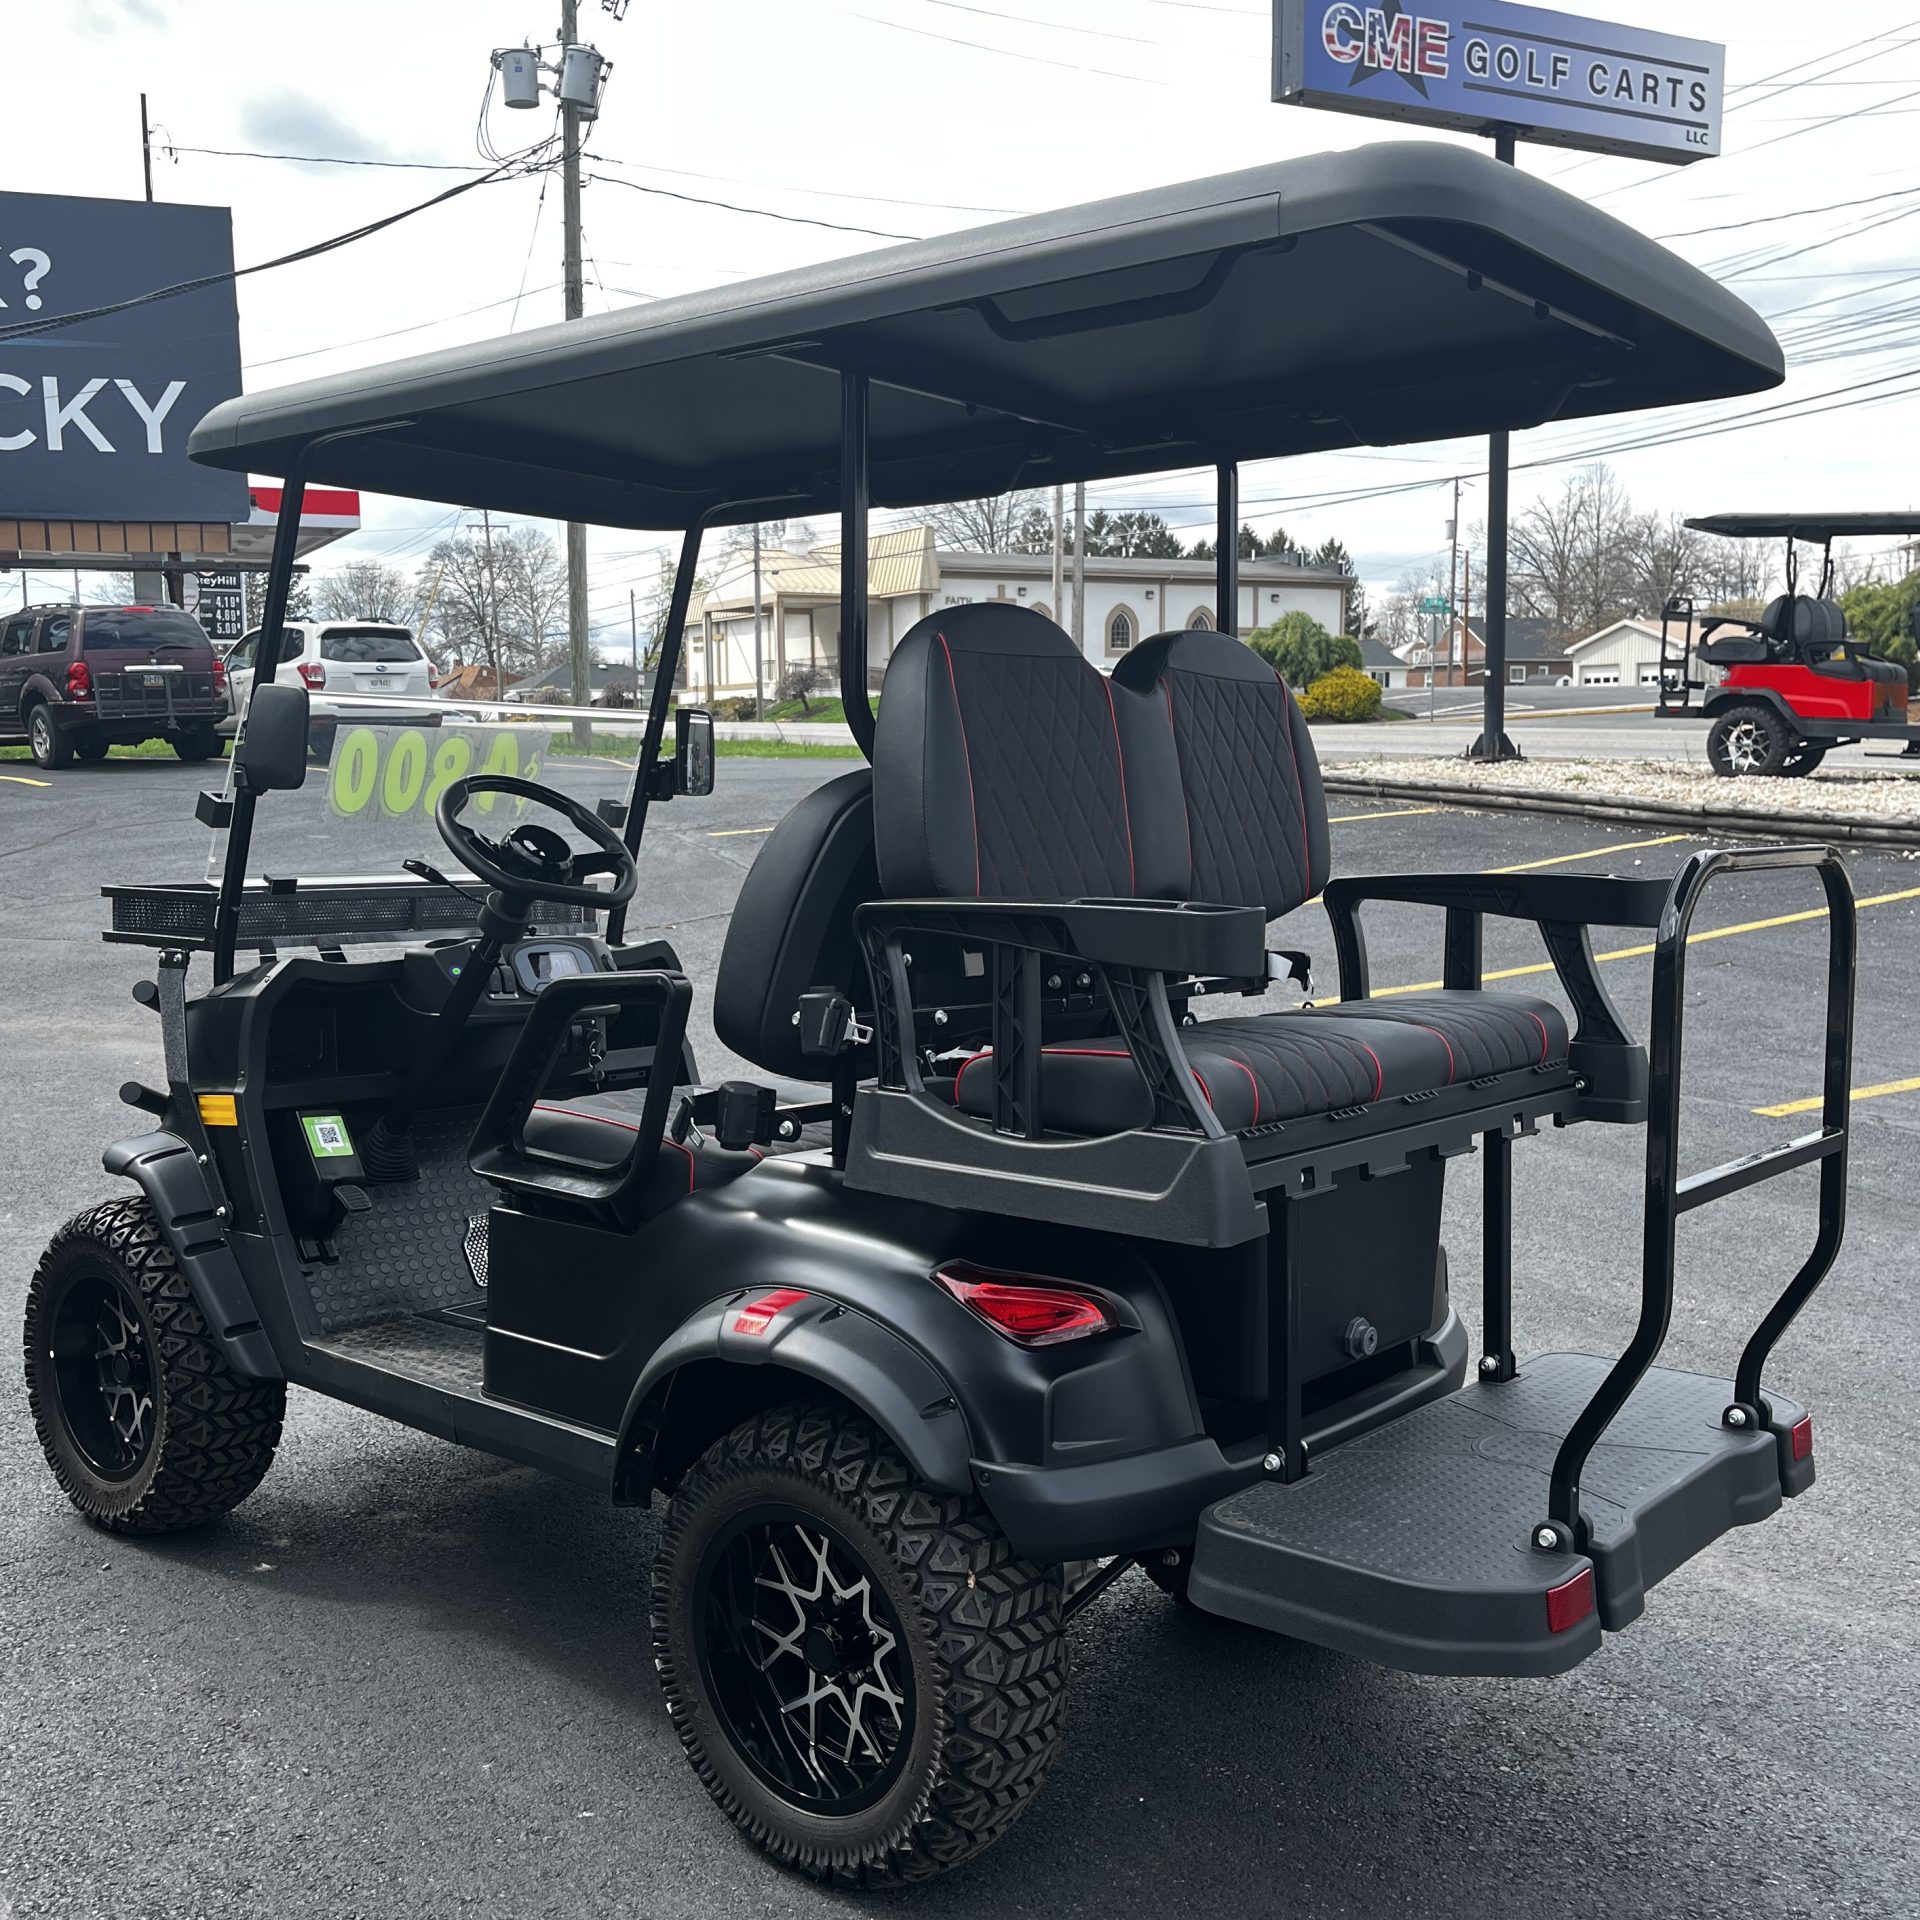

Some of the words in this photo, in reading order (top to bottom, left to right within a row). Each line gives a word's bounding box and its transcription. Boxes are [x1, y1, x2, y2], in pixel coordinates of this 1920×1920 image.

[1322, 2, 1449, 78] CME
[1465, 37, 1571, 90] GOLF
[1588, 63, 1708, 114] CARTS
[1686, 129, 1709, 146] LLC
